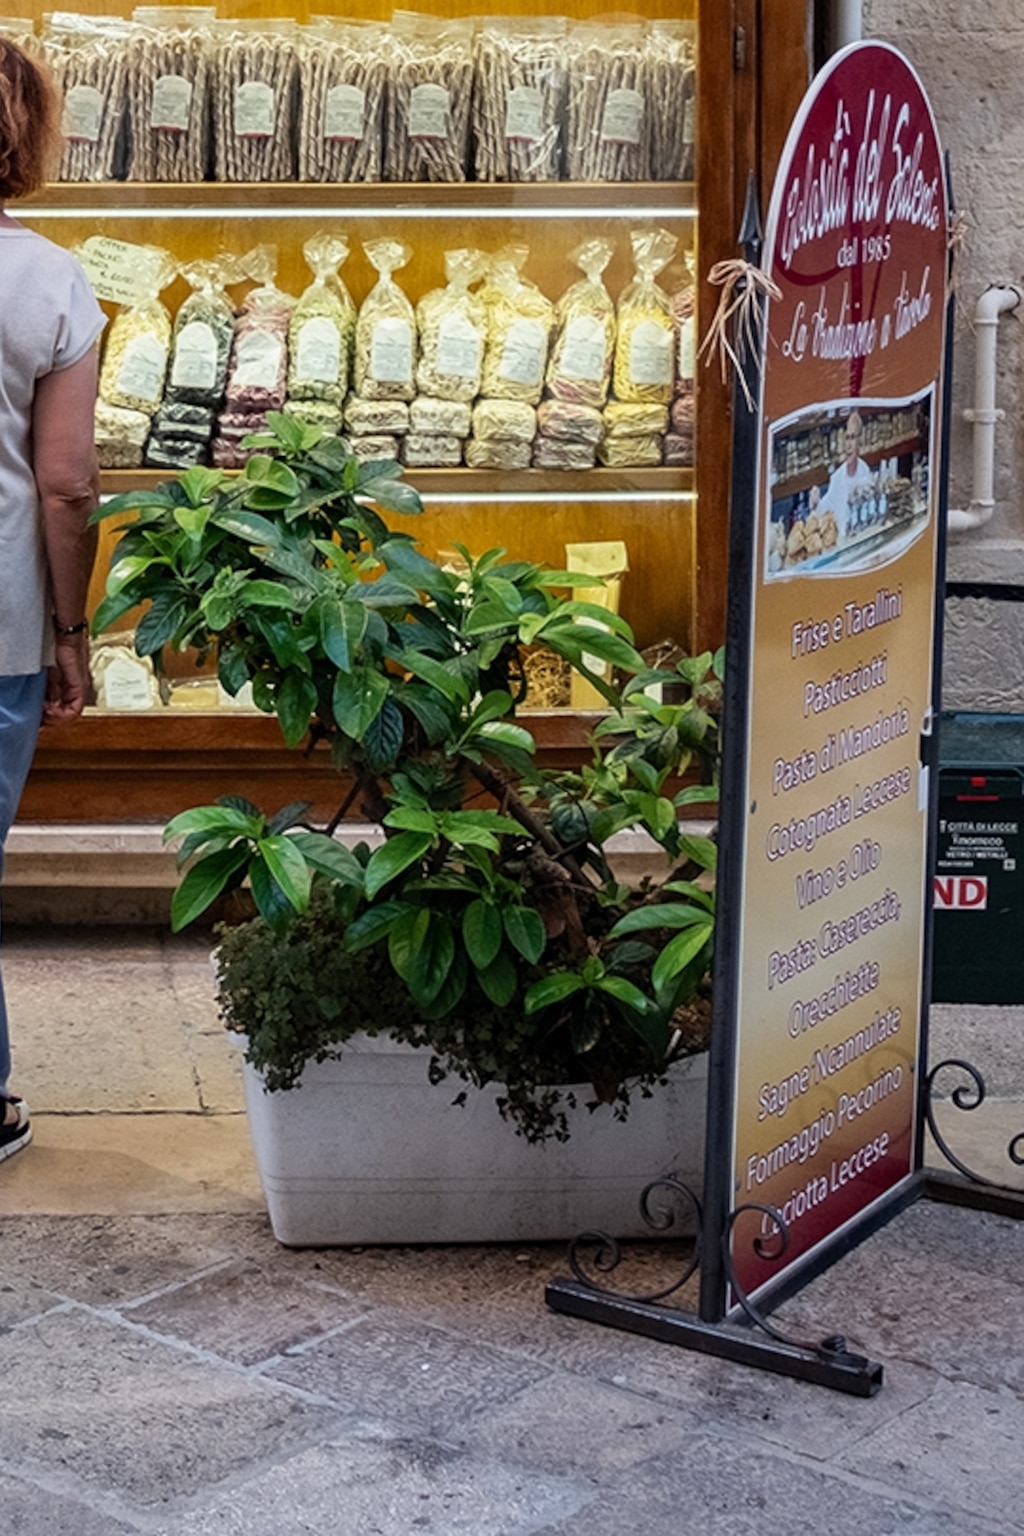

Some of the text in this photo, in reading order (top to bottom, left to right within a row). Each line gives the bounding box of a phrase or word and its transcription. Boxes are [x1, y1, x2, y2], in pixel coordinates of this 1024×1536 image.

[781, 98, 851, 270] Golosità
[852, 88, 891, 224] del
[837, 234, 892, 268] dal 1985
[781, 300, 808, 362] La
[880, 313, 891, 350] a
[894, 265, 932, 341] tavola
[791, 583, 904, 660] Frise e Tarallini
[803, 649, 888, 718] Pasticciotti
[772, 701, 910, 797] Pasta di Mandorla
[766, 766, 912, 862] Cotognata Leccese
[987, 821, 1018, 834] LECCE
[795, 838, 882, 910] Vino e Olio
[768, 938, 817, 991] Pasta:
[788, 961, 880, 1039] Orecchiette
[745, 1063, 904, 1192] Formaggio Pecorino
[757, 1065, 810, 1123] Sagne
[830, 1132, 890, 1194] Leccese
